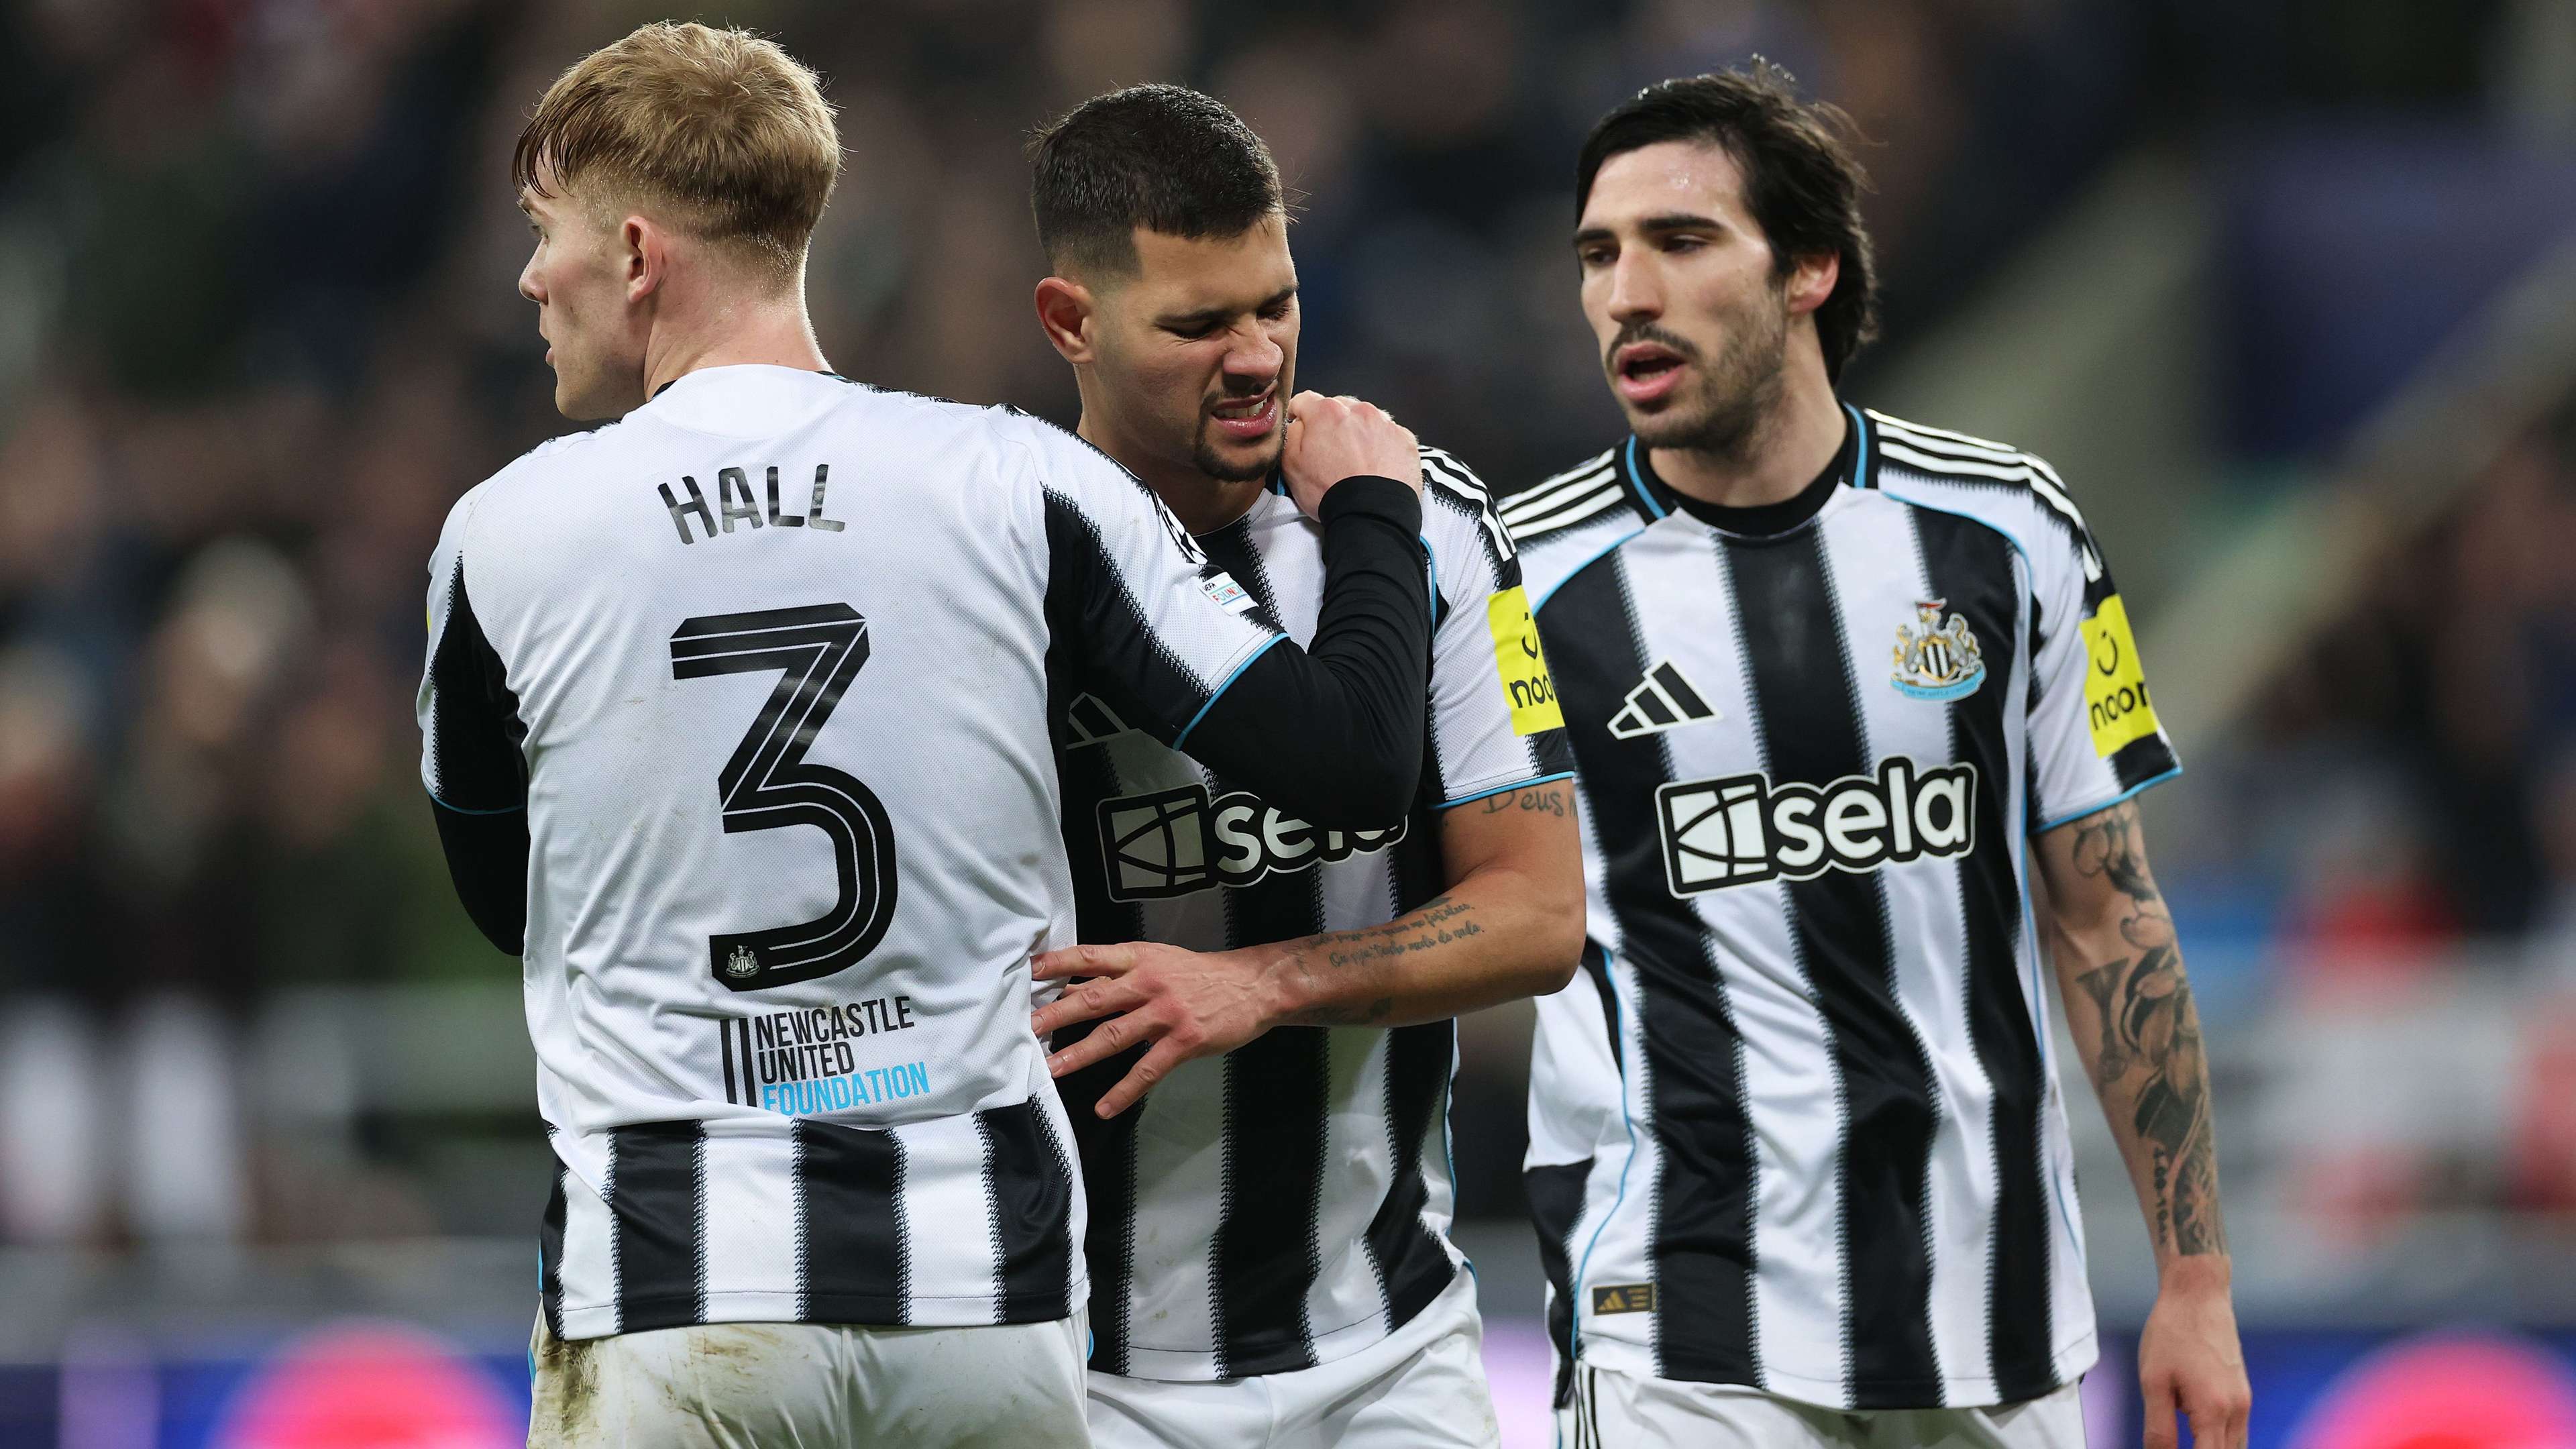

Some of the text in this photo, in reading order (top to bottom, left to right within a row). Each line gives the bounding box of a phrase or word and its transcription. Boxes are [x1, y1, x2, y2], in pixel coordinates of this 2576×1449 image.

[658, 464, 846, 545] HALL
[1203, 582, 1217, 591] UEFA
[1509, 674, 1554, 709] noo
[669, 602, 898, 992] 3
[1481, 790, 1564, 818] Deus
[1772, 765, 1966, 867] sela
[1214, 806, 1399, 873] se
[755, 996, 915, 1051] NEWCASTLE
[758, 1041, 855, 1085] UNITED
[763, 1061, 930, 1116] FOUNDATION
